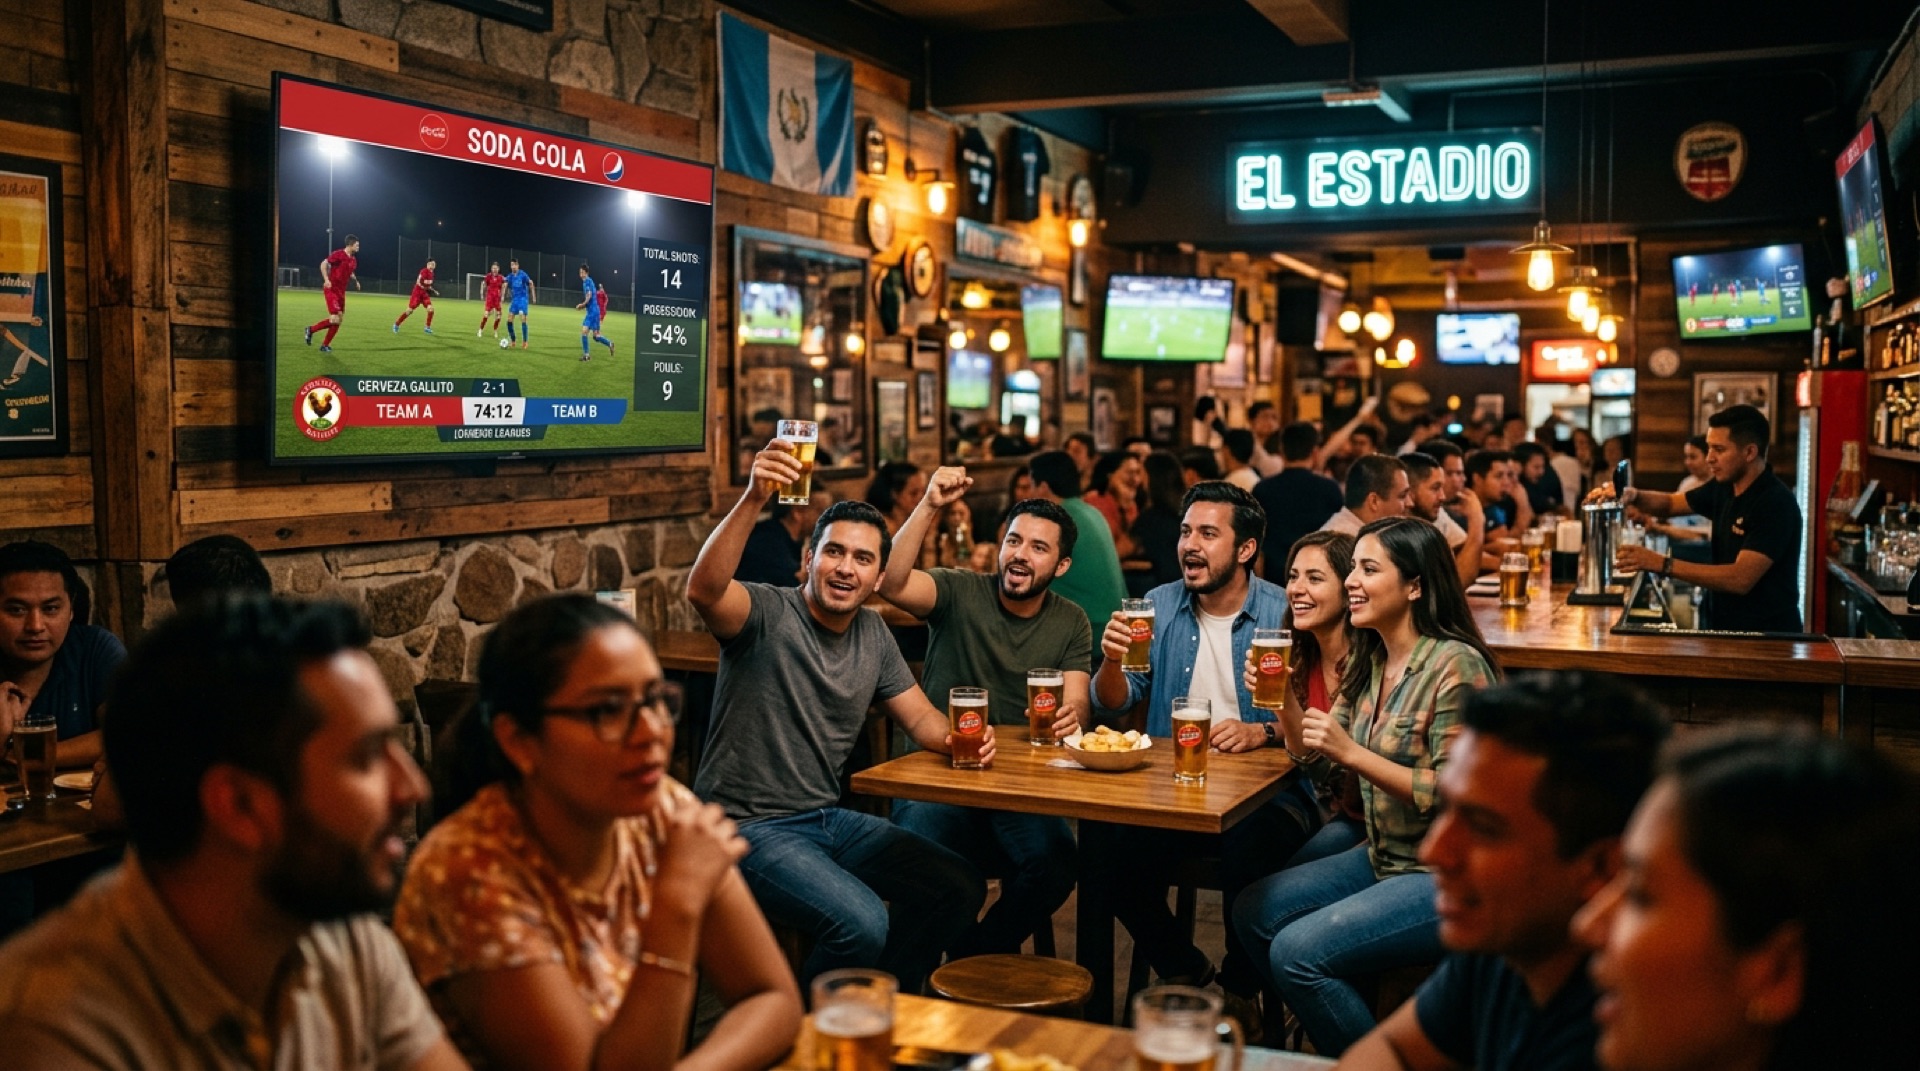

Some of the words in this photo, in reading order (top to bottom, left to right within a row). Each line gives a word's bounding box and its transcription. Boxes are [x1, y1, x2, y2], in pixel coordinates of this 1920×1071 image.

[467, 127, 526, 163] SODA
[532, 141, 586, 174] COLA
[1236, 154, 1296, 210] EL
[1308, 142, 1531, 207] ESTADIO
[643, 247, 670, 261] TOTAL
[660, 269, 682, 289] 14
[652, 324, 687, 346] 54%
[358, 380, 408, 393] CERVEZA
[409, 381, 454, 393] GALLITO
[662, 380, 673, 401] 9
[376, 403, 419, 419] TEAM
[423, 403, 433, 419] A
[474, 403, 513, 419] 74:12
[552, 404, 586, 418] TEAM
[589, 405, 598, 418] B
